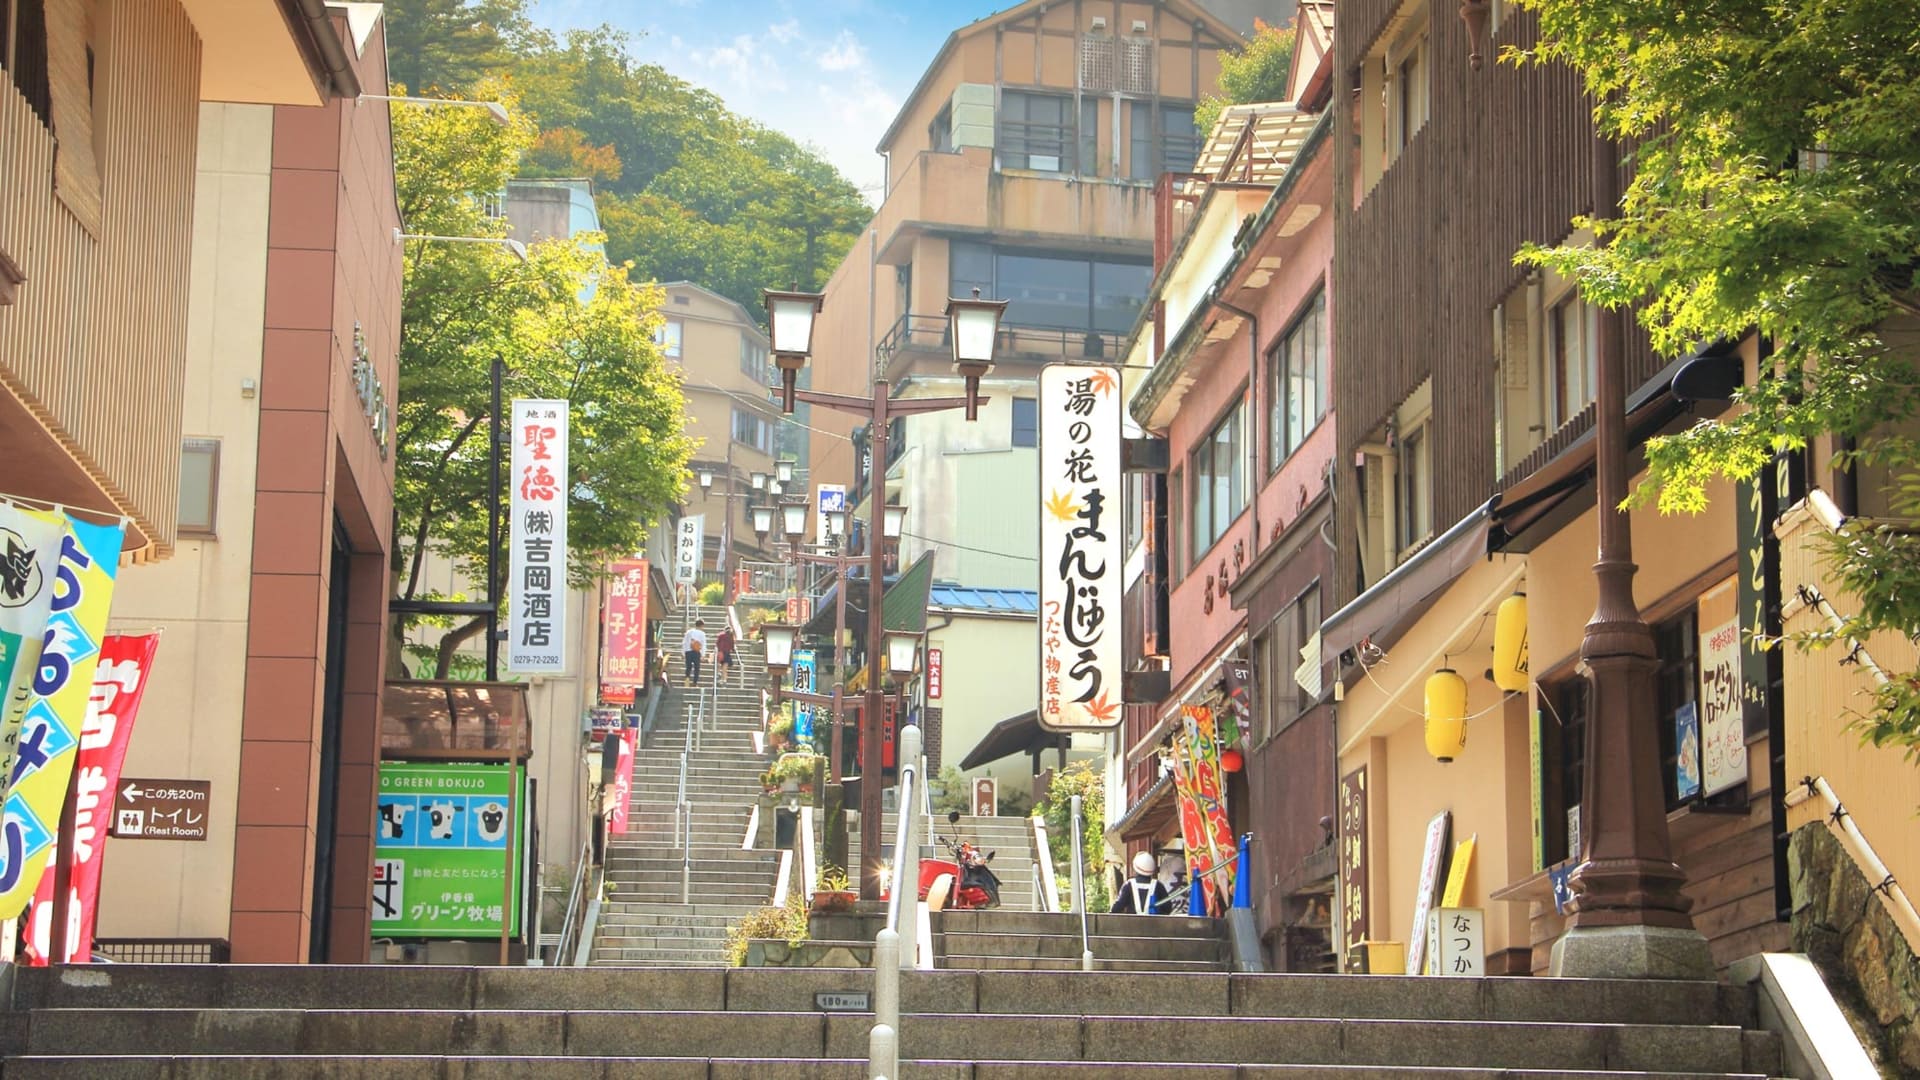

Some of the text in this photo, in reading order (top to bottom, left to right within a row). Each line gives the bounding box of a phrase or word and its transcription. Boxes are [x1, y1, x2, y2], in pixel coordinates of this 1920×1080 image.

[525, 409, 557, 419] 地酒
[520, 424, 560, 501] 聖徳
[680, 522, 694, 578] おかし屋
[1060, 379, 1107, 703] 湯の花まんじゅう
[624, 568, 641, 651] 手打ラーメン
[513, 656, 559, 665] 0279-72-2292
[1045, 600, 1060, 715] つたや物産店
[394, 777, 432, 787] GREEN
[145, 788, 205, 800] この先20m
[151, 807, 202, 824] トイレ
[144, 826, 204, 836] (Rest Room)
[441, 893, 474, 903] 伊香保
[411, 902, 503, 922] グリーン牧場
[1453, 915, 1472, 973] なつか
